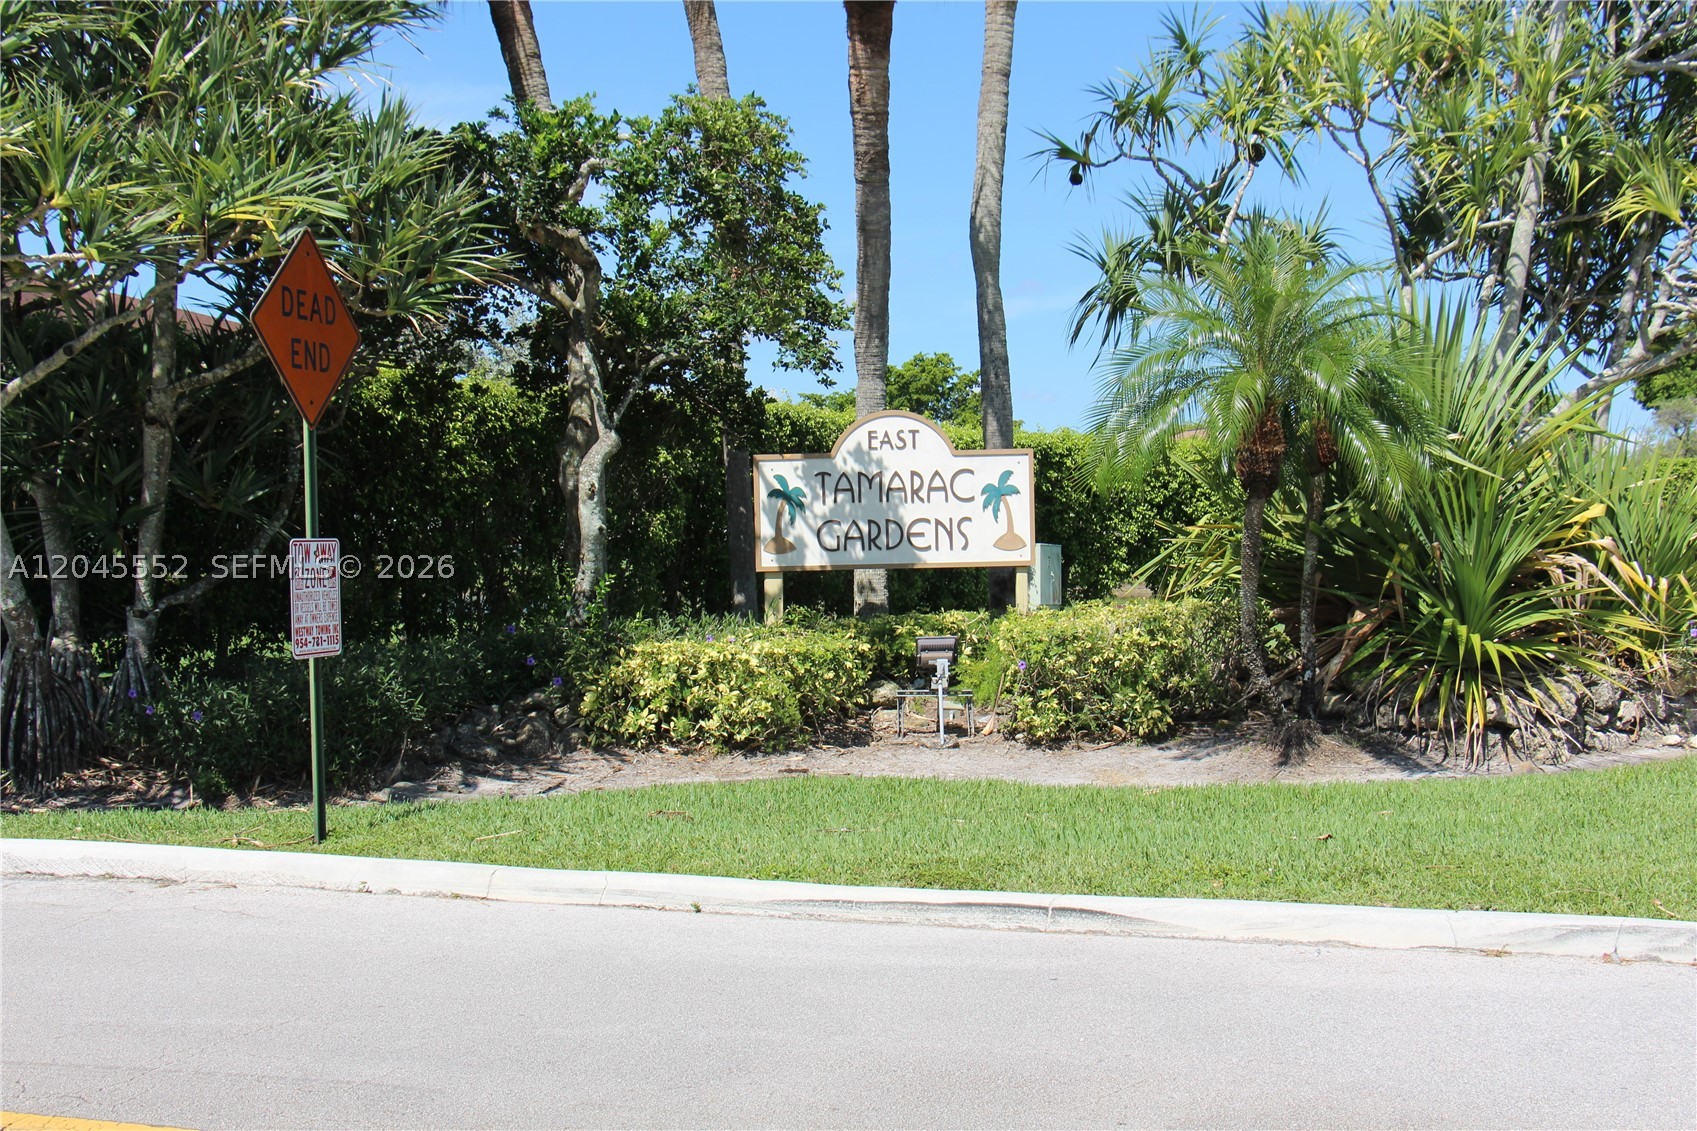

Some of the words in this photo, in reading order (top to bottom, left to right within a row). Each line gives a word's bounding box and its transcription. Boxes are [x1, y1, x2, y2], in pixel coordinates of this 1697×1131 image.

[281, 285, 336, 325] DEAD
[291, 338, 331, 373] END
[867, 429, 920, 451] EAST
[814, 468, 975, 506] TAMARAC
[816, 516, 972, 552] GARDENS
[293, 543, 311, 564] TOW
[314, 543, 337, 563] AWAY
[304, 567, 327, 589] ZONE
[295, 626, 314, 637] WESTWAY
[315, 624, 331, 636] TOWING
